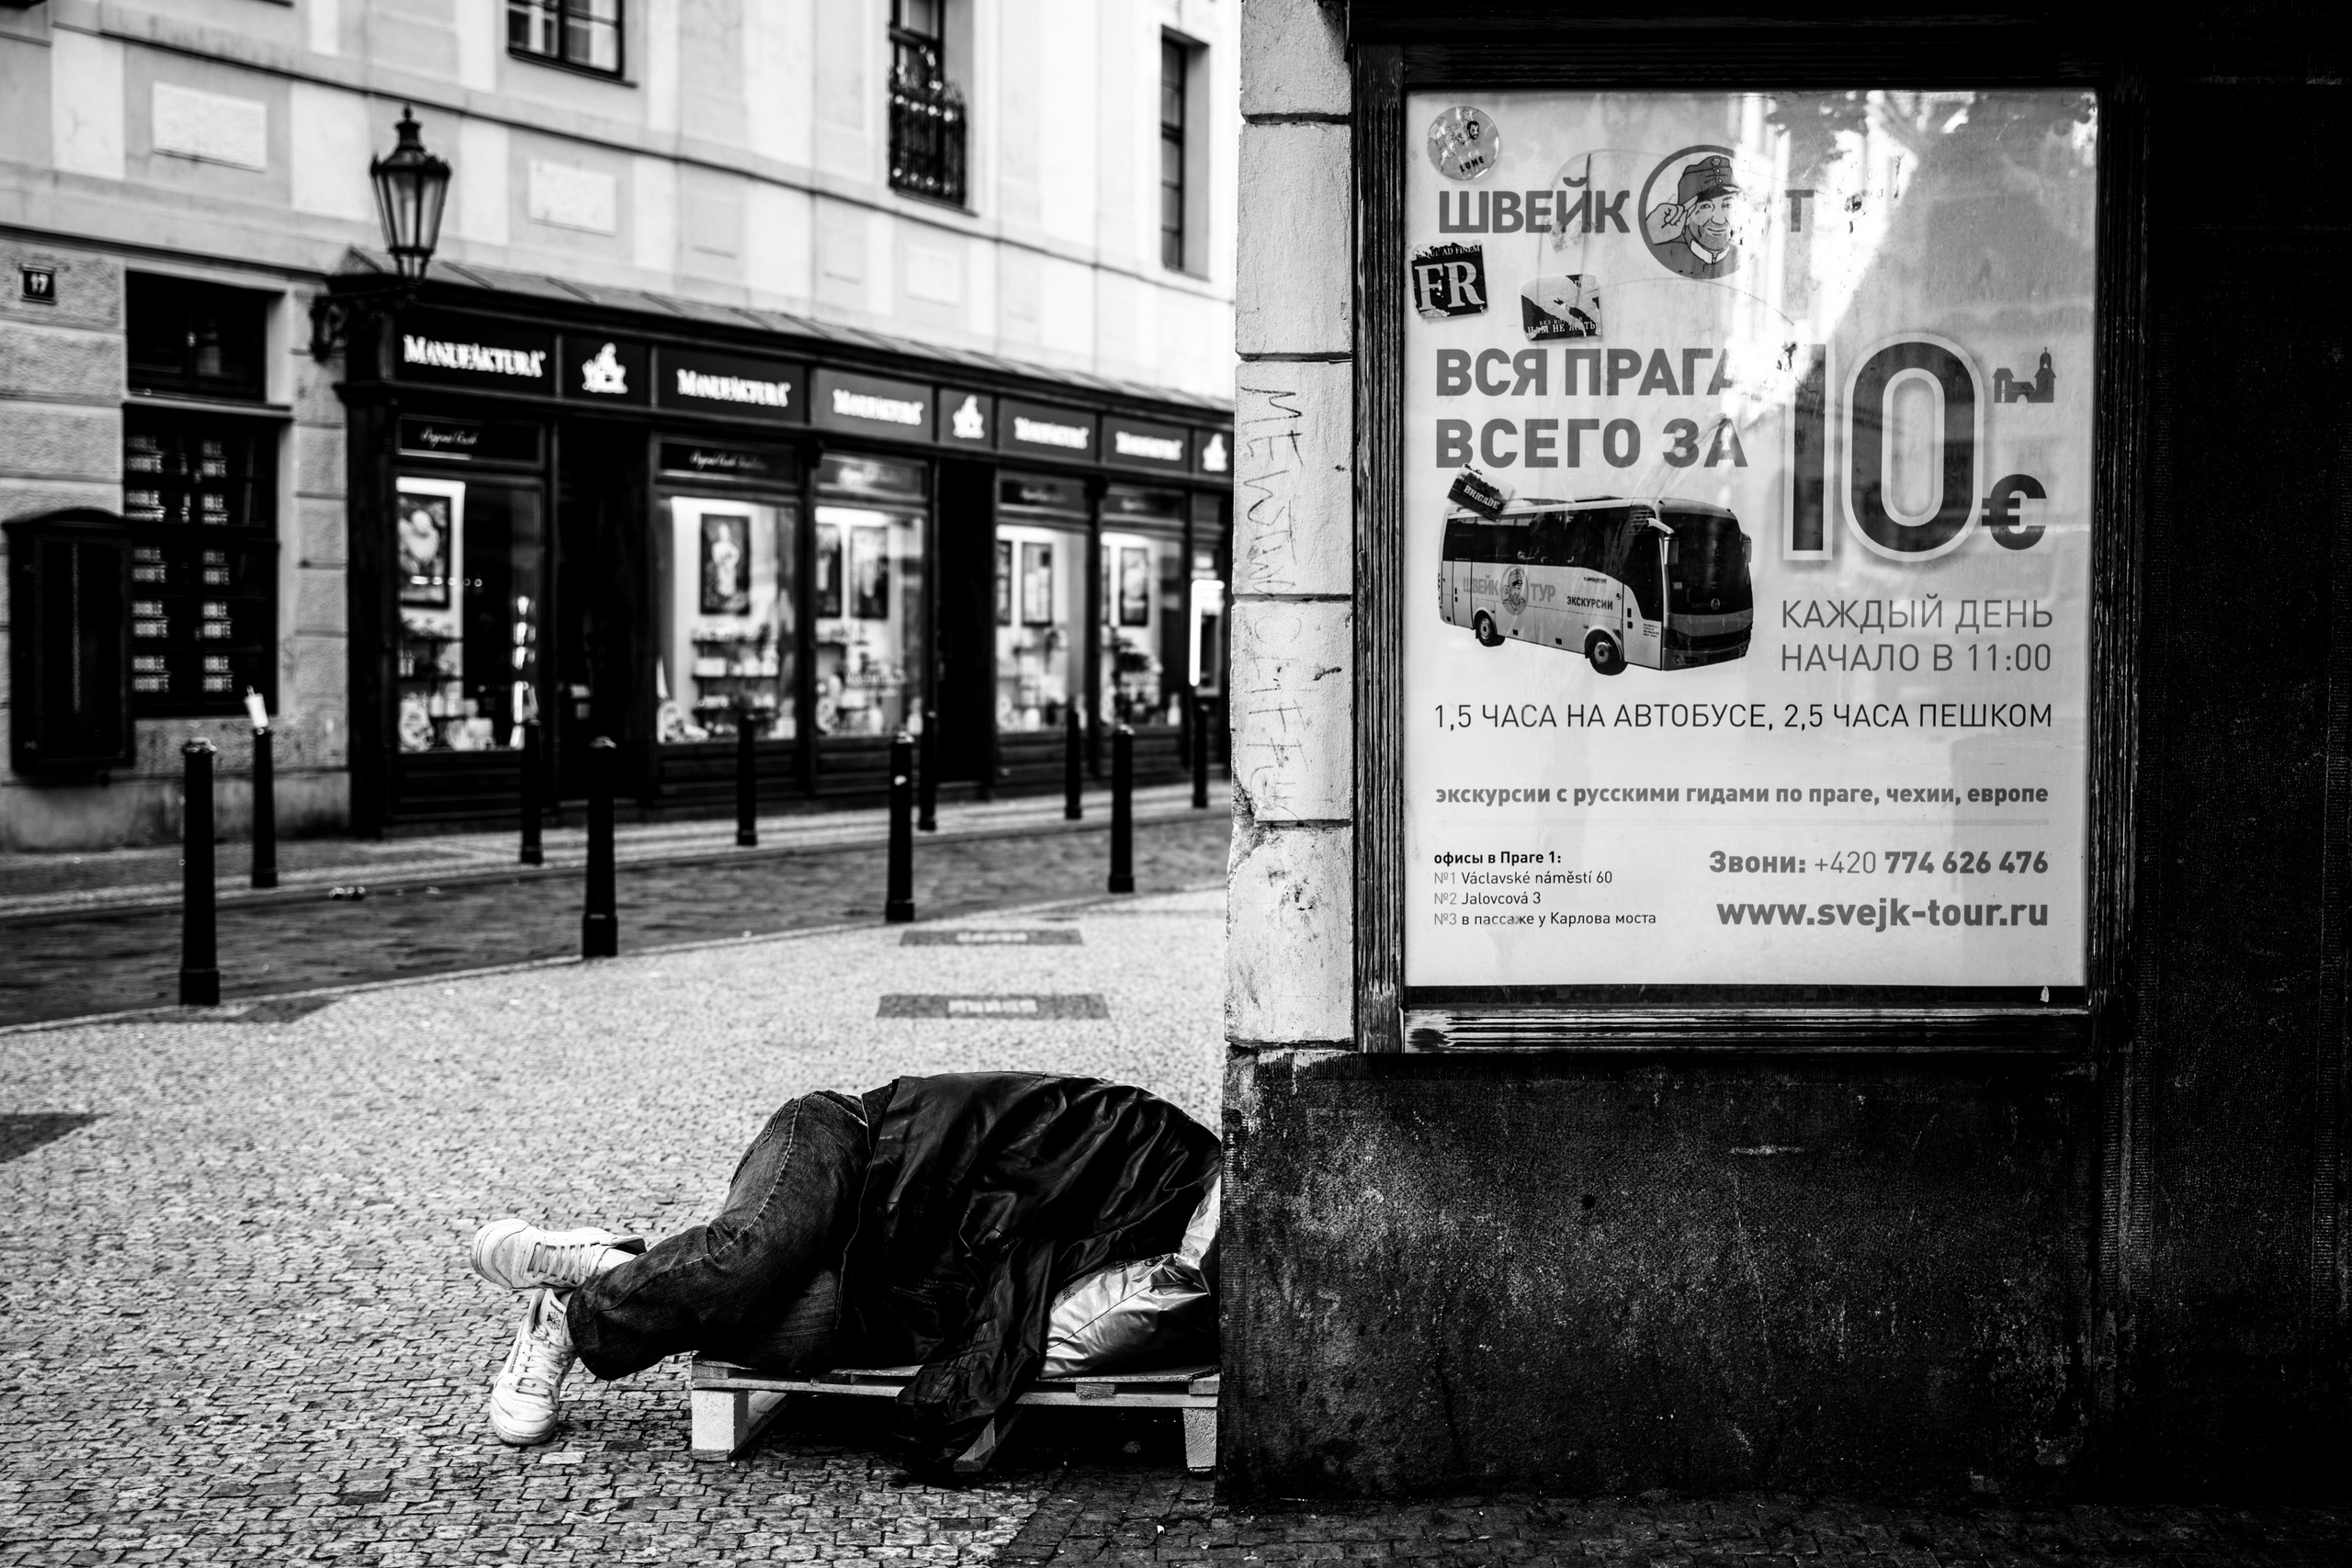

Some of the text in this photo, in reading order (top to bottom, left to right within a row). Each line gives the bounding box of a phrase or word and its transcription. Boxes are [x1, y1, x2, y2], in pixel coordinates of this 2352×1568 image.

[1459, 155, 1485, 173] LUME
[1439, 177, 1630, 233] ШВЕЙК
[1442, 247, 1453, 256] AD
[1455, 244, 1480, 254] FINEM
[1414, 261, 1486, 310] FR
[1527, 325, 1549, 333] НМ
[1552, 323, 1566, 333] НЕ
[1436, 348, 1548, 397] ВСЯ
[1436, 418, 1748, 468] ВСЕГО ЗА
[1792, 341, 1976, 552] 10
[1463, 484, 1500, 510] BRIGADE
[1463, 574, 1556, 604] ШВЕЙК ТУР
[1566, 595, 1613, 611] ЭКСКУРСИИ
[1782, 593, 2052, 634] КАЖДЫЙ ДЕНЬ
[1782, 643, 2052, 671] НАЧАЛО В 11:00
[1435, 703, 2052, 731] 1,5 ЧАСА НА АВТОБУСЕ, 2,5 ЧАСА ПЕШКОМ
[1435, 786, 2049, 807] экскурсии с русскими гидами по праге, чехии, европе
[1434, 851, 1561, 867] офисы в Праге 1:
[1709, 850, 2049, 874] Звони: +420 774 626 476
[1434, 870, 1612, 885] №1 Václavské náměstí 60
[1434, 891, 1541, 906] №2 Jalovcová 3
[1434, 911, 1657, 928] №3 в пассаже у Карлова моста
[1717, 898, 2048, 932] www.svejk-tour.ru
